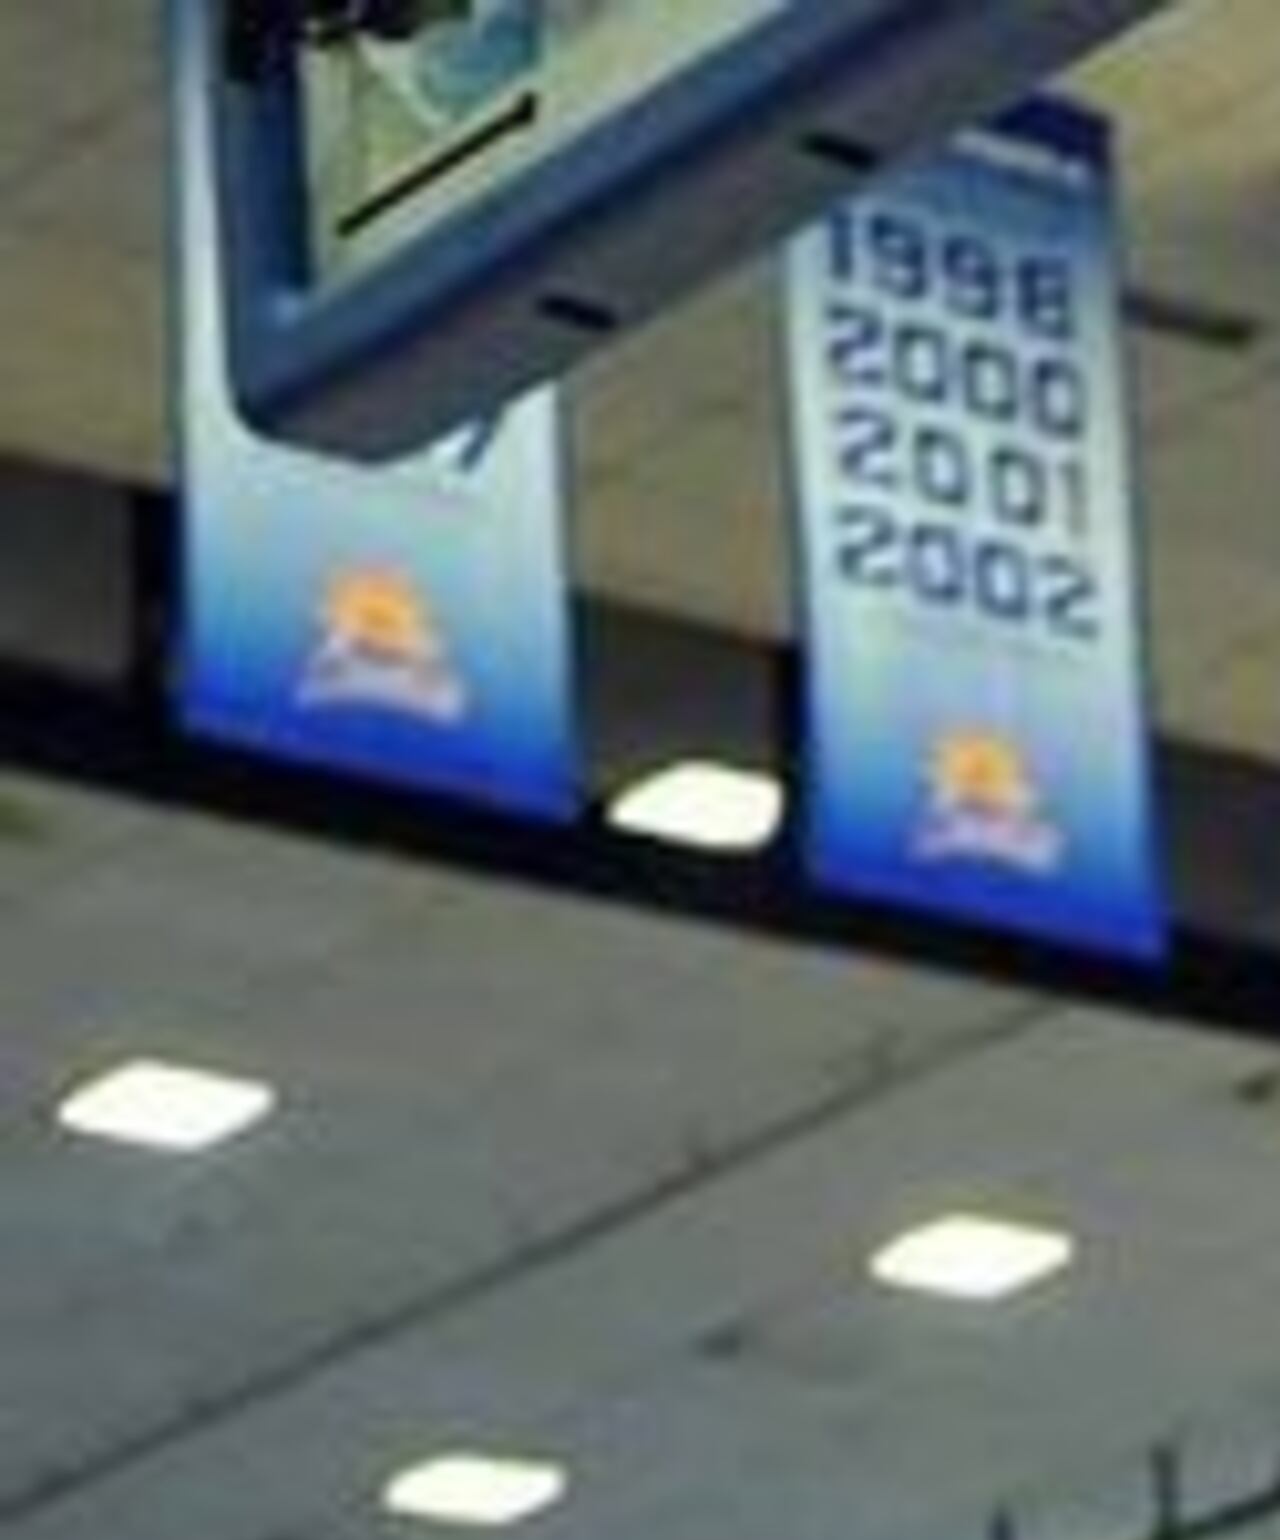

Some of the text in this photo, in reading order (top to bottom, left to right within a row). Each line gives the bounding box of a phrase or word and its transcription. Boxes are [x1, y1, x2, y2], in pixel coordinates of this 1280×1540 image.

[826, 305, 1085, 438] 2000
[838, 405, 1090, 540] 2001
[838, 503, 1104, 645] 2002
